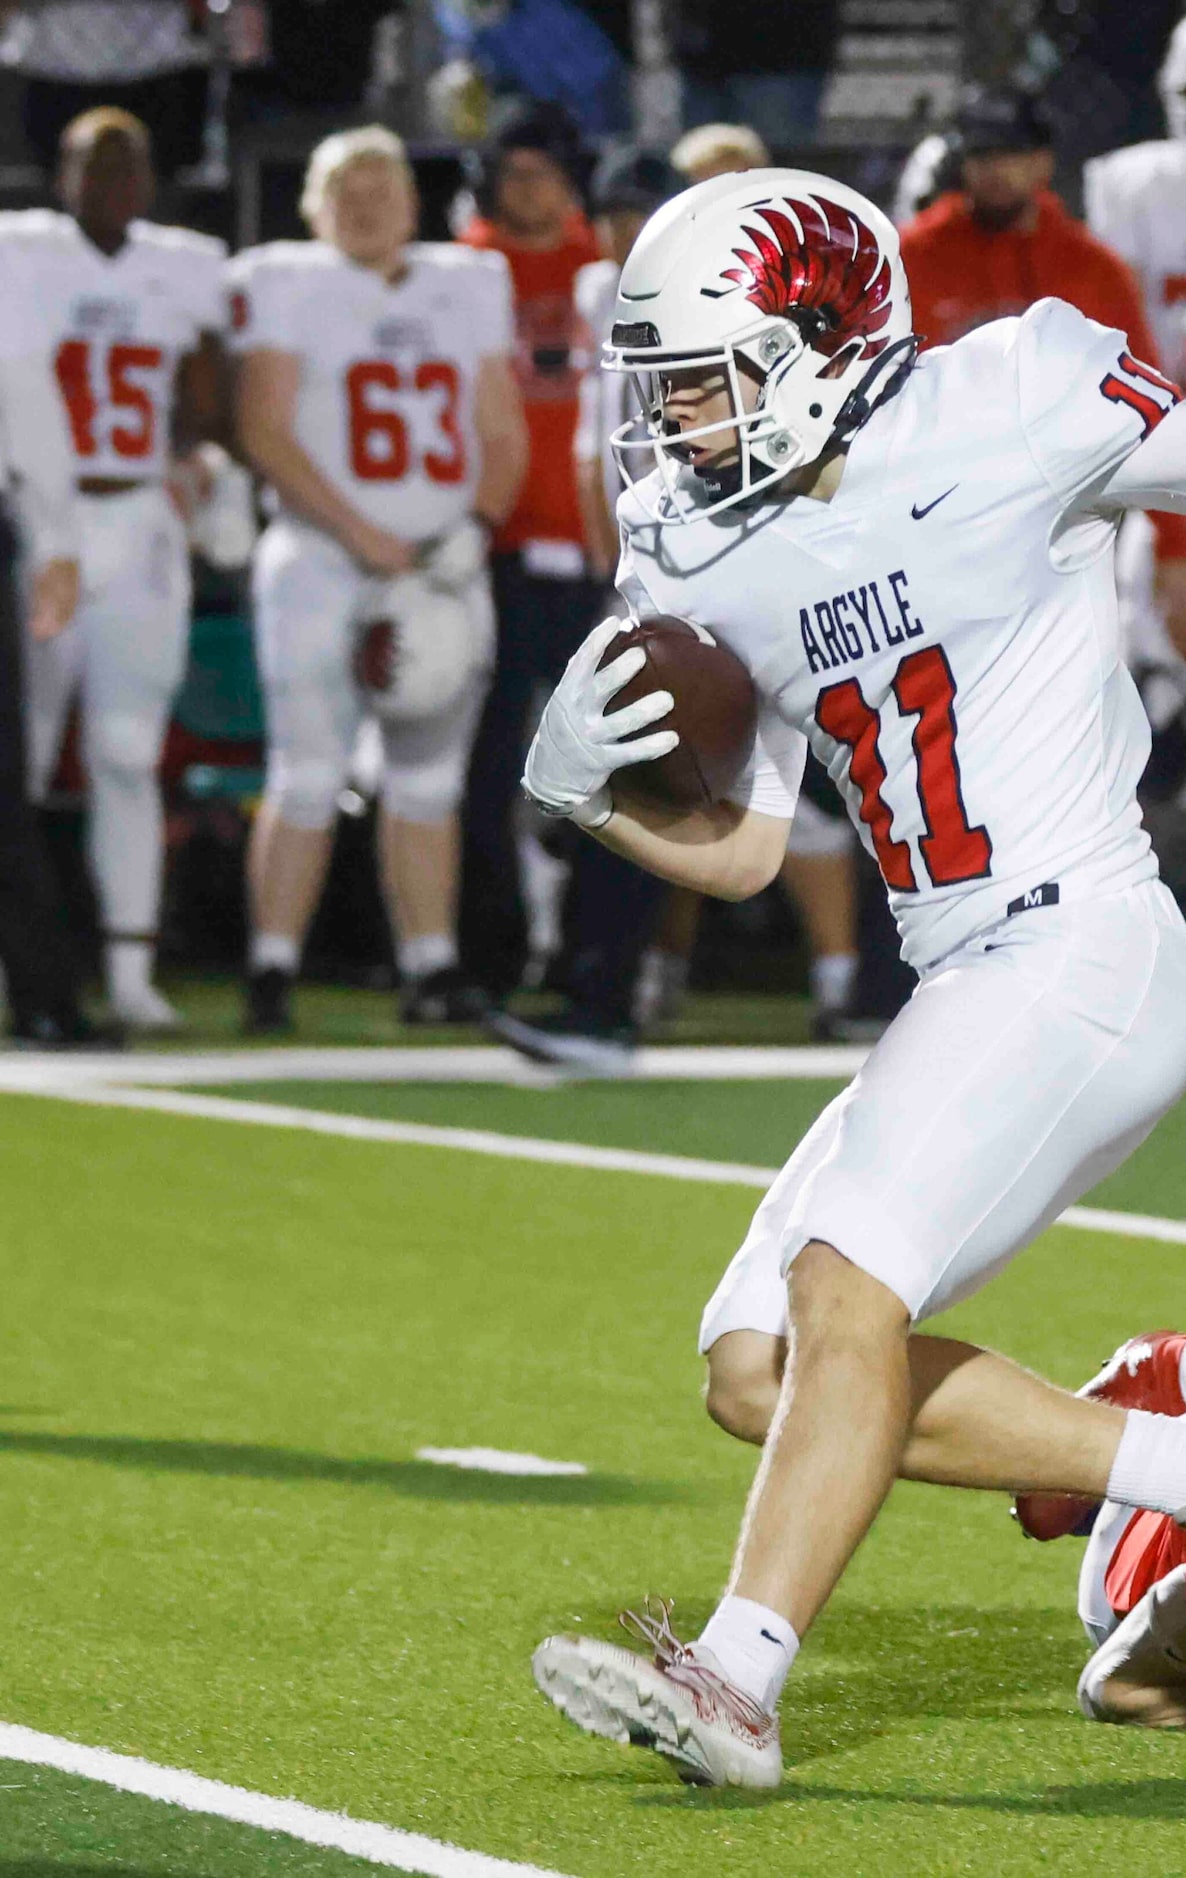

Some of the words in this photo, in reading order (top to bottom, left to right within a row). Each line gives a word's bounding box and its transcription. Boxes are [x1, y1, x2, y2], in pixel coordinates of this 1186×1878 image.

[56, 341, 161, 458] 15
[347, 361, 464, 482] 63
[799, 569, 924, 674] ARGYLE
[814, 642, 993, 893] 11
[1024, 888, 1042, 907] M
